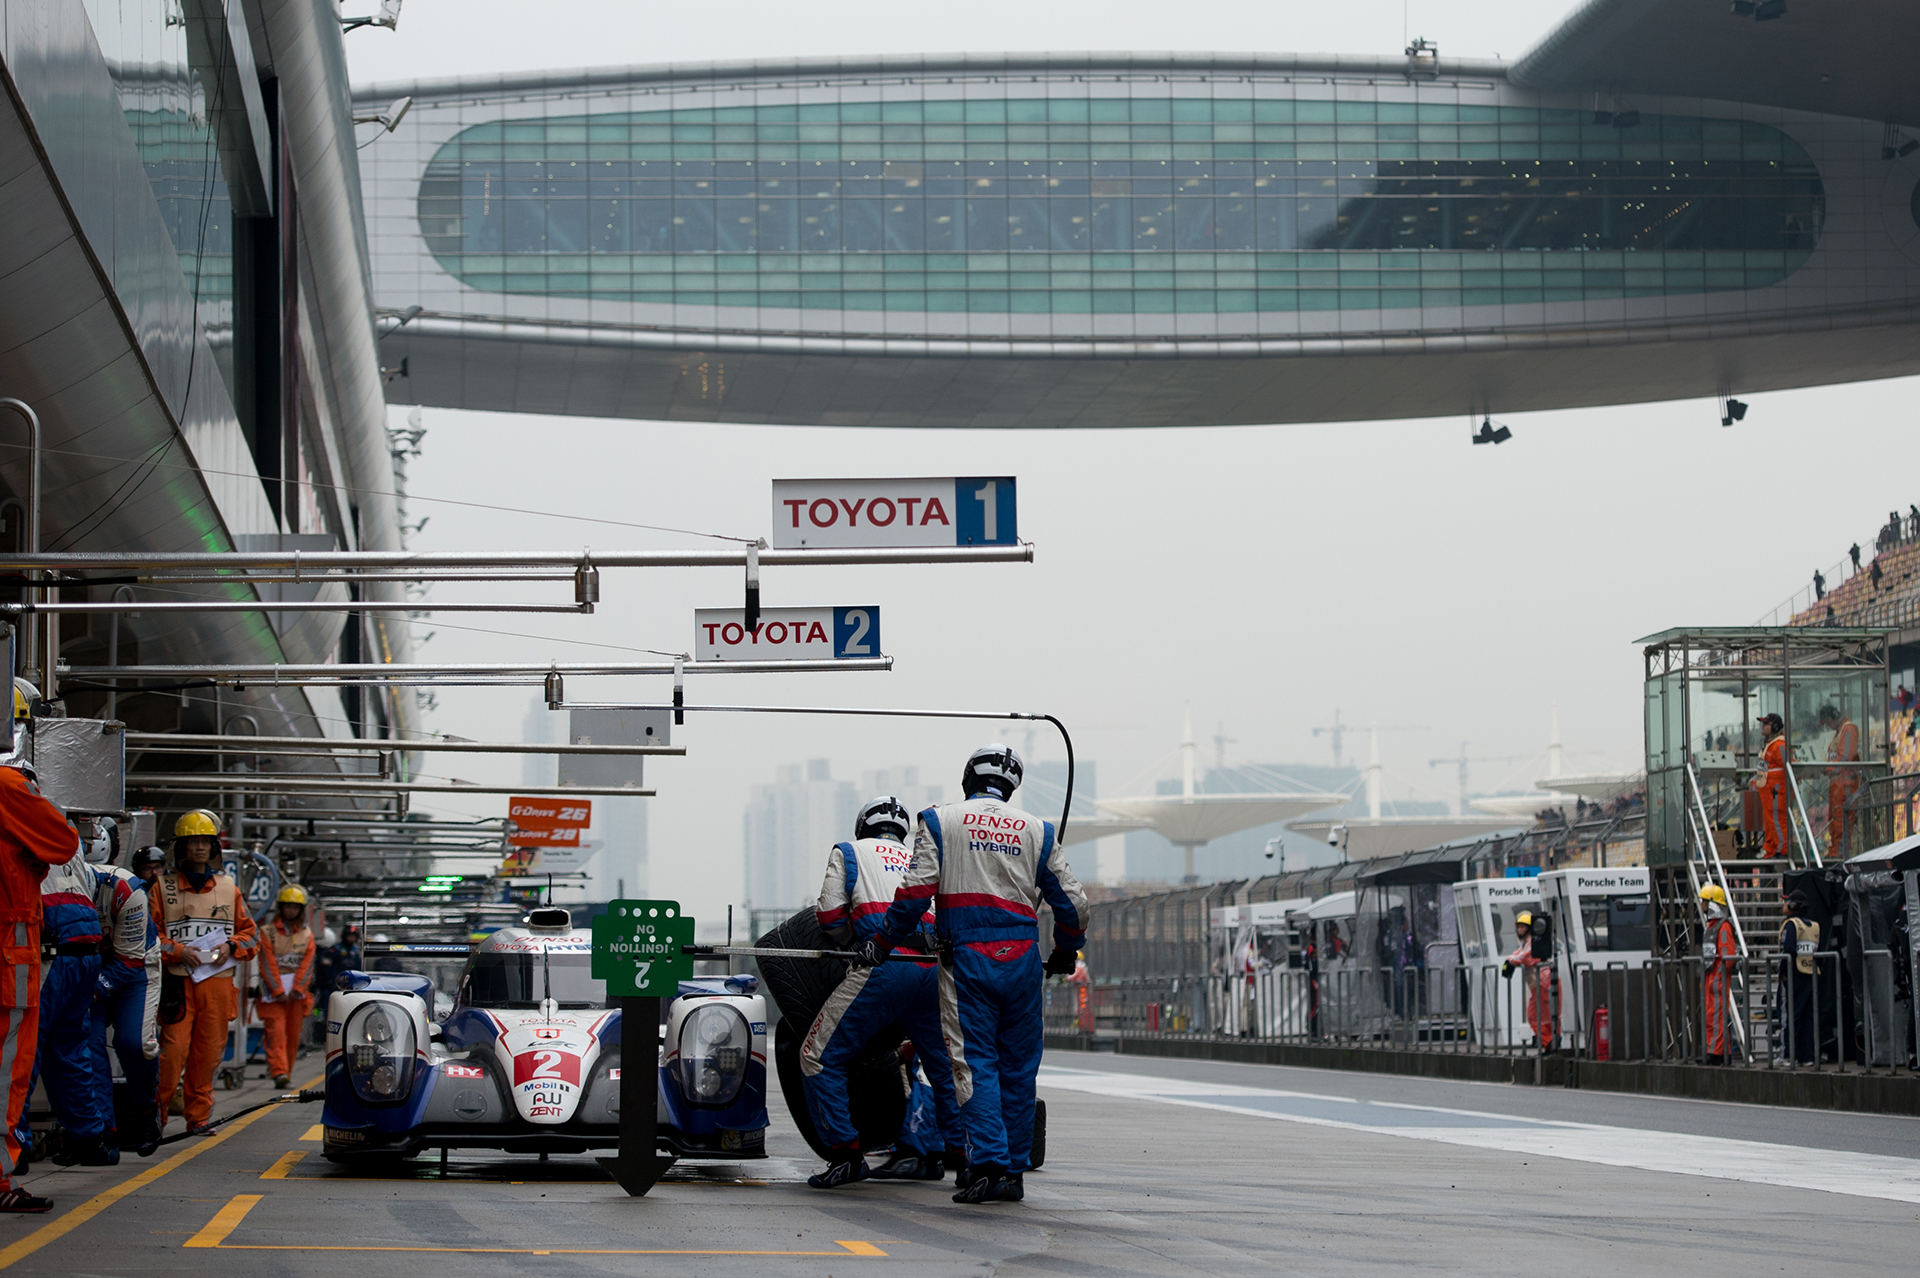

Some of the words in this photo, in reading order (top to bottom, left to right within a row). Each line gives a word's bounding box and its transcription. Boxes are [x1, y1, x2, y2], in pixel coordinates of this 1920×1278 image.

[783, 497, 950, 528] TOYOTA
[974, 480, 998, 541] 1
[702, 621, 829, 646] TOYOTA
[844, 609, 871, 654] 2
[557, 807, 589, 821] 26
[962, 813, 1027, 831] DENSO
[968, 829, 1022, 846] TOYOTA
[969, 841, 1022, 857] HYBRID
[516, 851, 536, 867] 17
[248, 876, 270, 900] 28
[1578, 876, 1616, 888] Porsche
[1618, 876, 1645, 887] Team
[164, 879, 178, 905] 2015
[1488, 887, 1524, 897] Porsche
[170, 925, 192, 940] PIT
[195, 925, 233, 939] LAE
[636, 924, 656, 935] ON
[490, 943, 540, 951] TOYOTA
[513, 936, 583, 944] DENSO
[609, 943, 669, 954] IGNITION
[634, 961, 651, 989] 2
[519, 1017, 577, 1025] TOYOTA
[803, 1012, 824, 1056] DENSO
[447, 1066, 481, 1077] HY
[532, 1050, 562, 1079] 2
[524, 1081, 557, 1092] Mobil
[529, 1106, 563, 1117] ZENT
